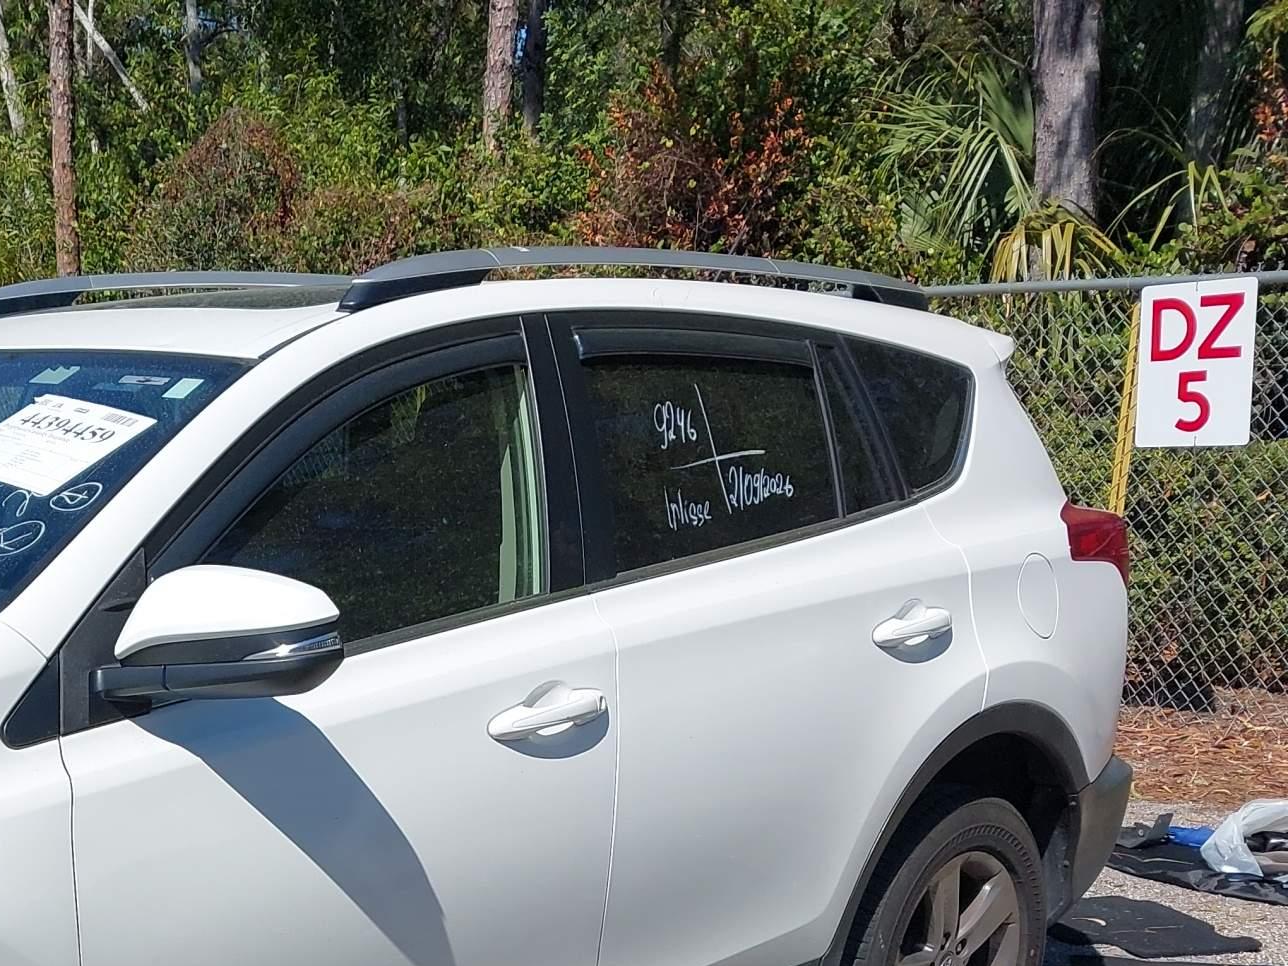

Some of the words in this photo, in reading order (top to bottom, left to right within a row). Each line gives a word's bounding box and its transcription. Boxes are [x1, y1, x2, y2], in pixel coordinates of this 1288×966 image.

[1150, 292, 1246, 363] DZ
[20, 411, 116, 443] 44394459
[653, 401, 697, 449] 9246
[1174, 370, 1211, 433] 5
